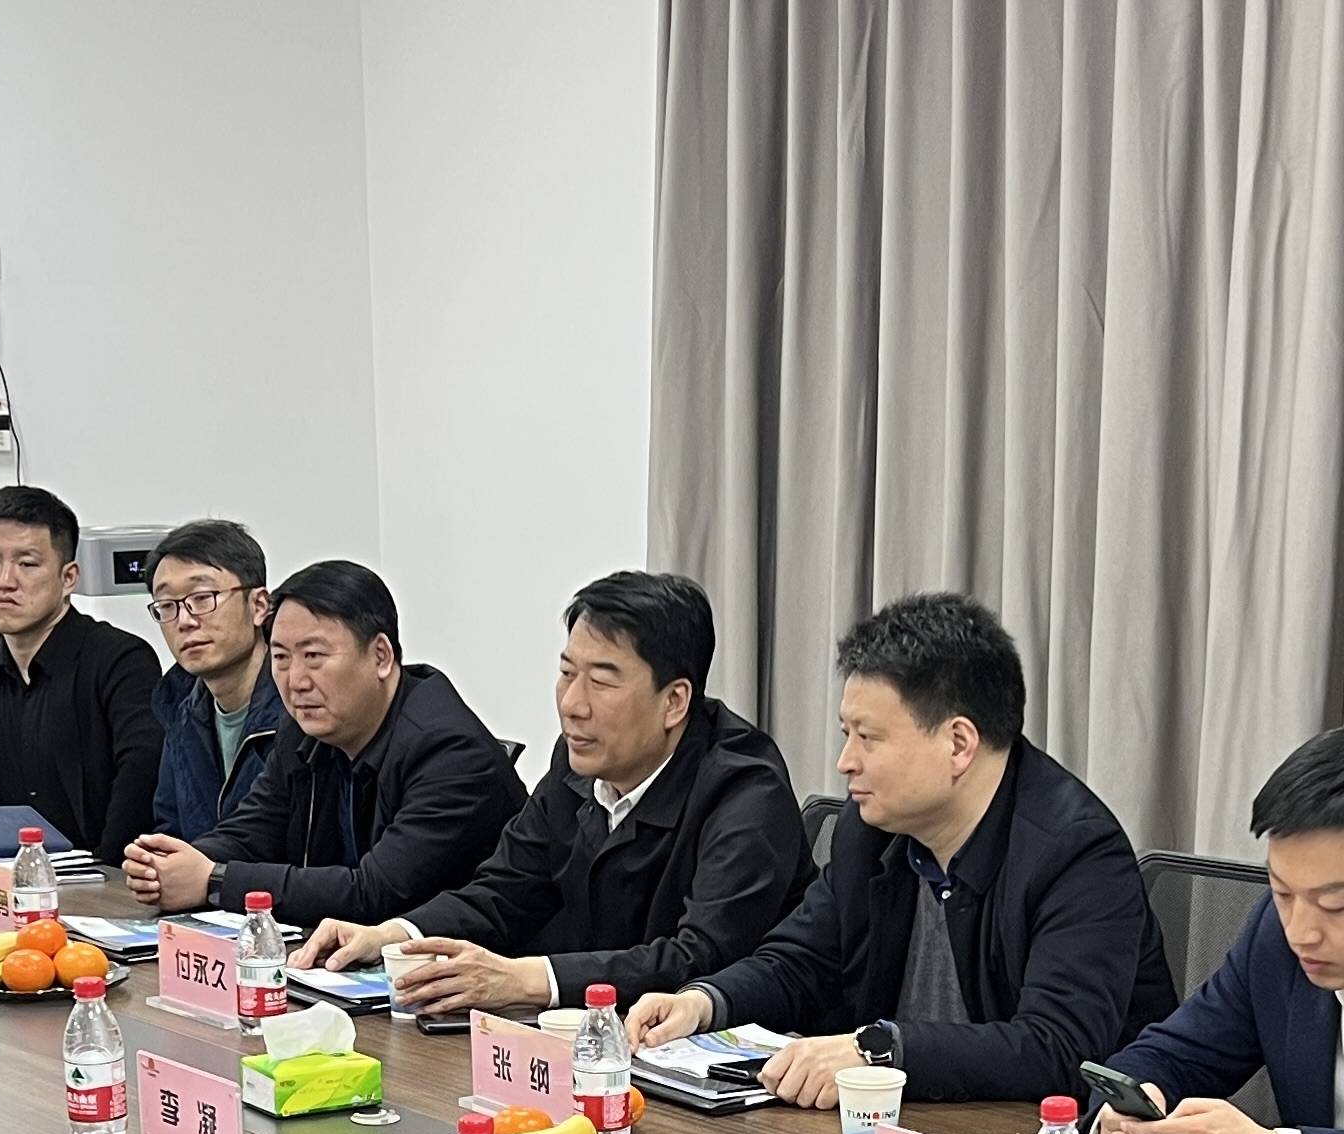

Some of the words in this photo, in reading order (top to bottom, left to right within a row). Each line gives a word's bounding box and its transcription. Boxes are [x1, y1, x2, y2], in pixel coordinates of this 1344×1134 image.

[175, 948, 228, 991] 付永久
[492, 1045, 513, 1082] 张
[529, 1057, 550, 1095] 纲
[159, 1088, 180, 1127] 李
